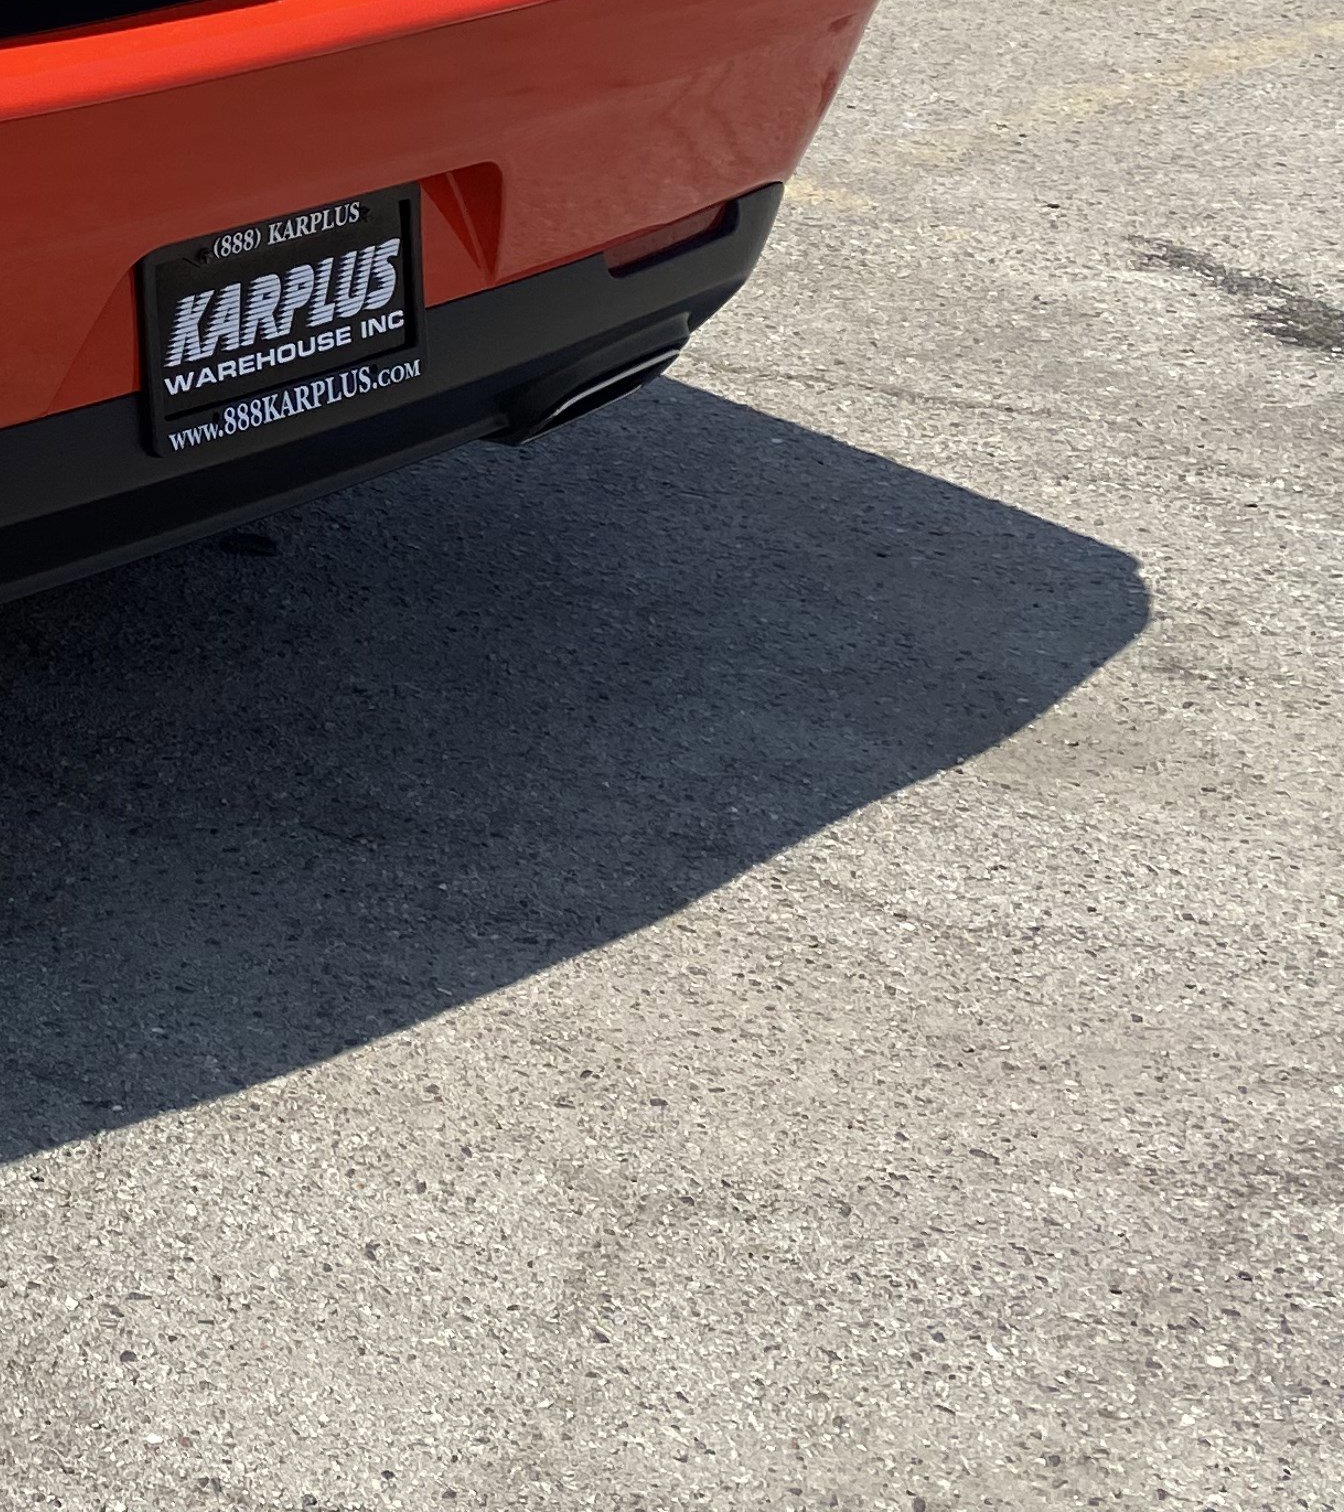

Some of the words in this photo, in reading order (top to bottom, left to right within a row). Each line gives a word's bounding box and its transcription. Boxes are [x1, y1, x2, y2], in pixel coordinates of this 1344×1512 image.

[213, 228, 262, 258] (888)
[267, 201, 361, 246] KARPLUS
[163, 237, 402, 368] KARPLUS
[164, 325, 352, 395] WAREHOUSE
[361, 309, 405, 339] INC
